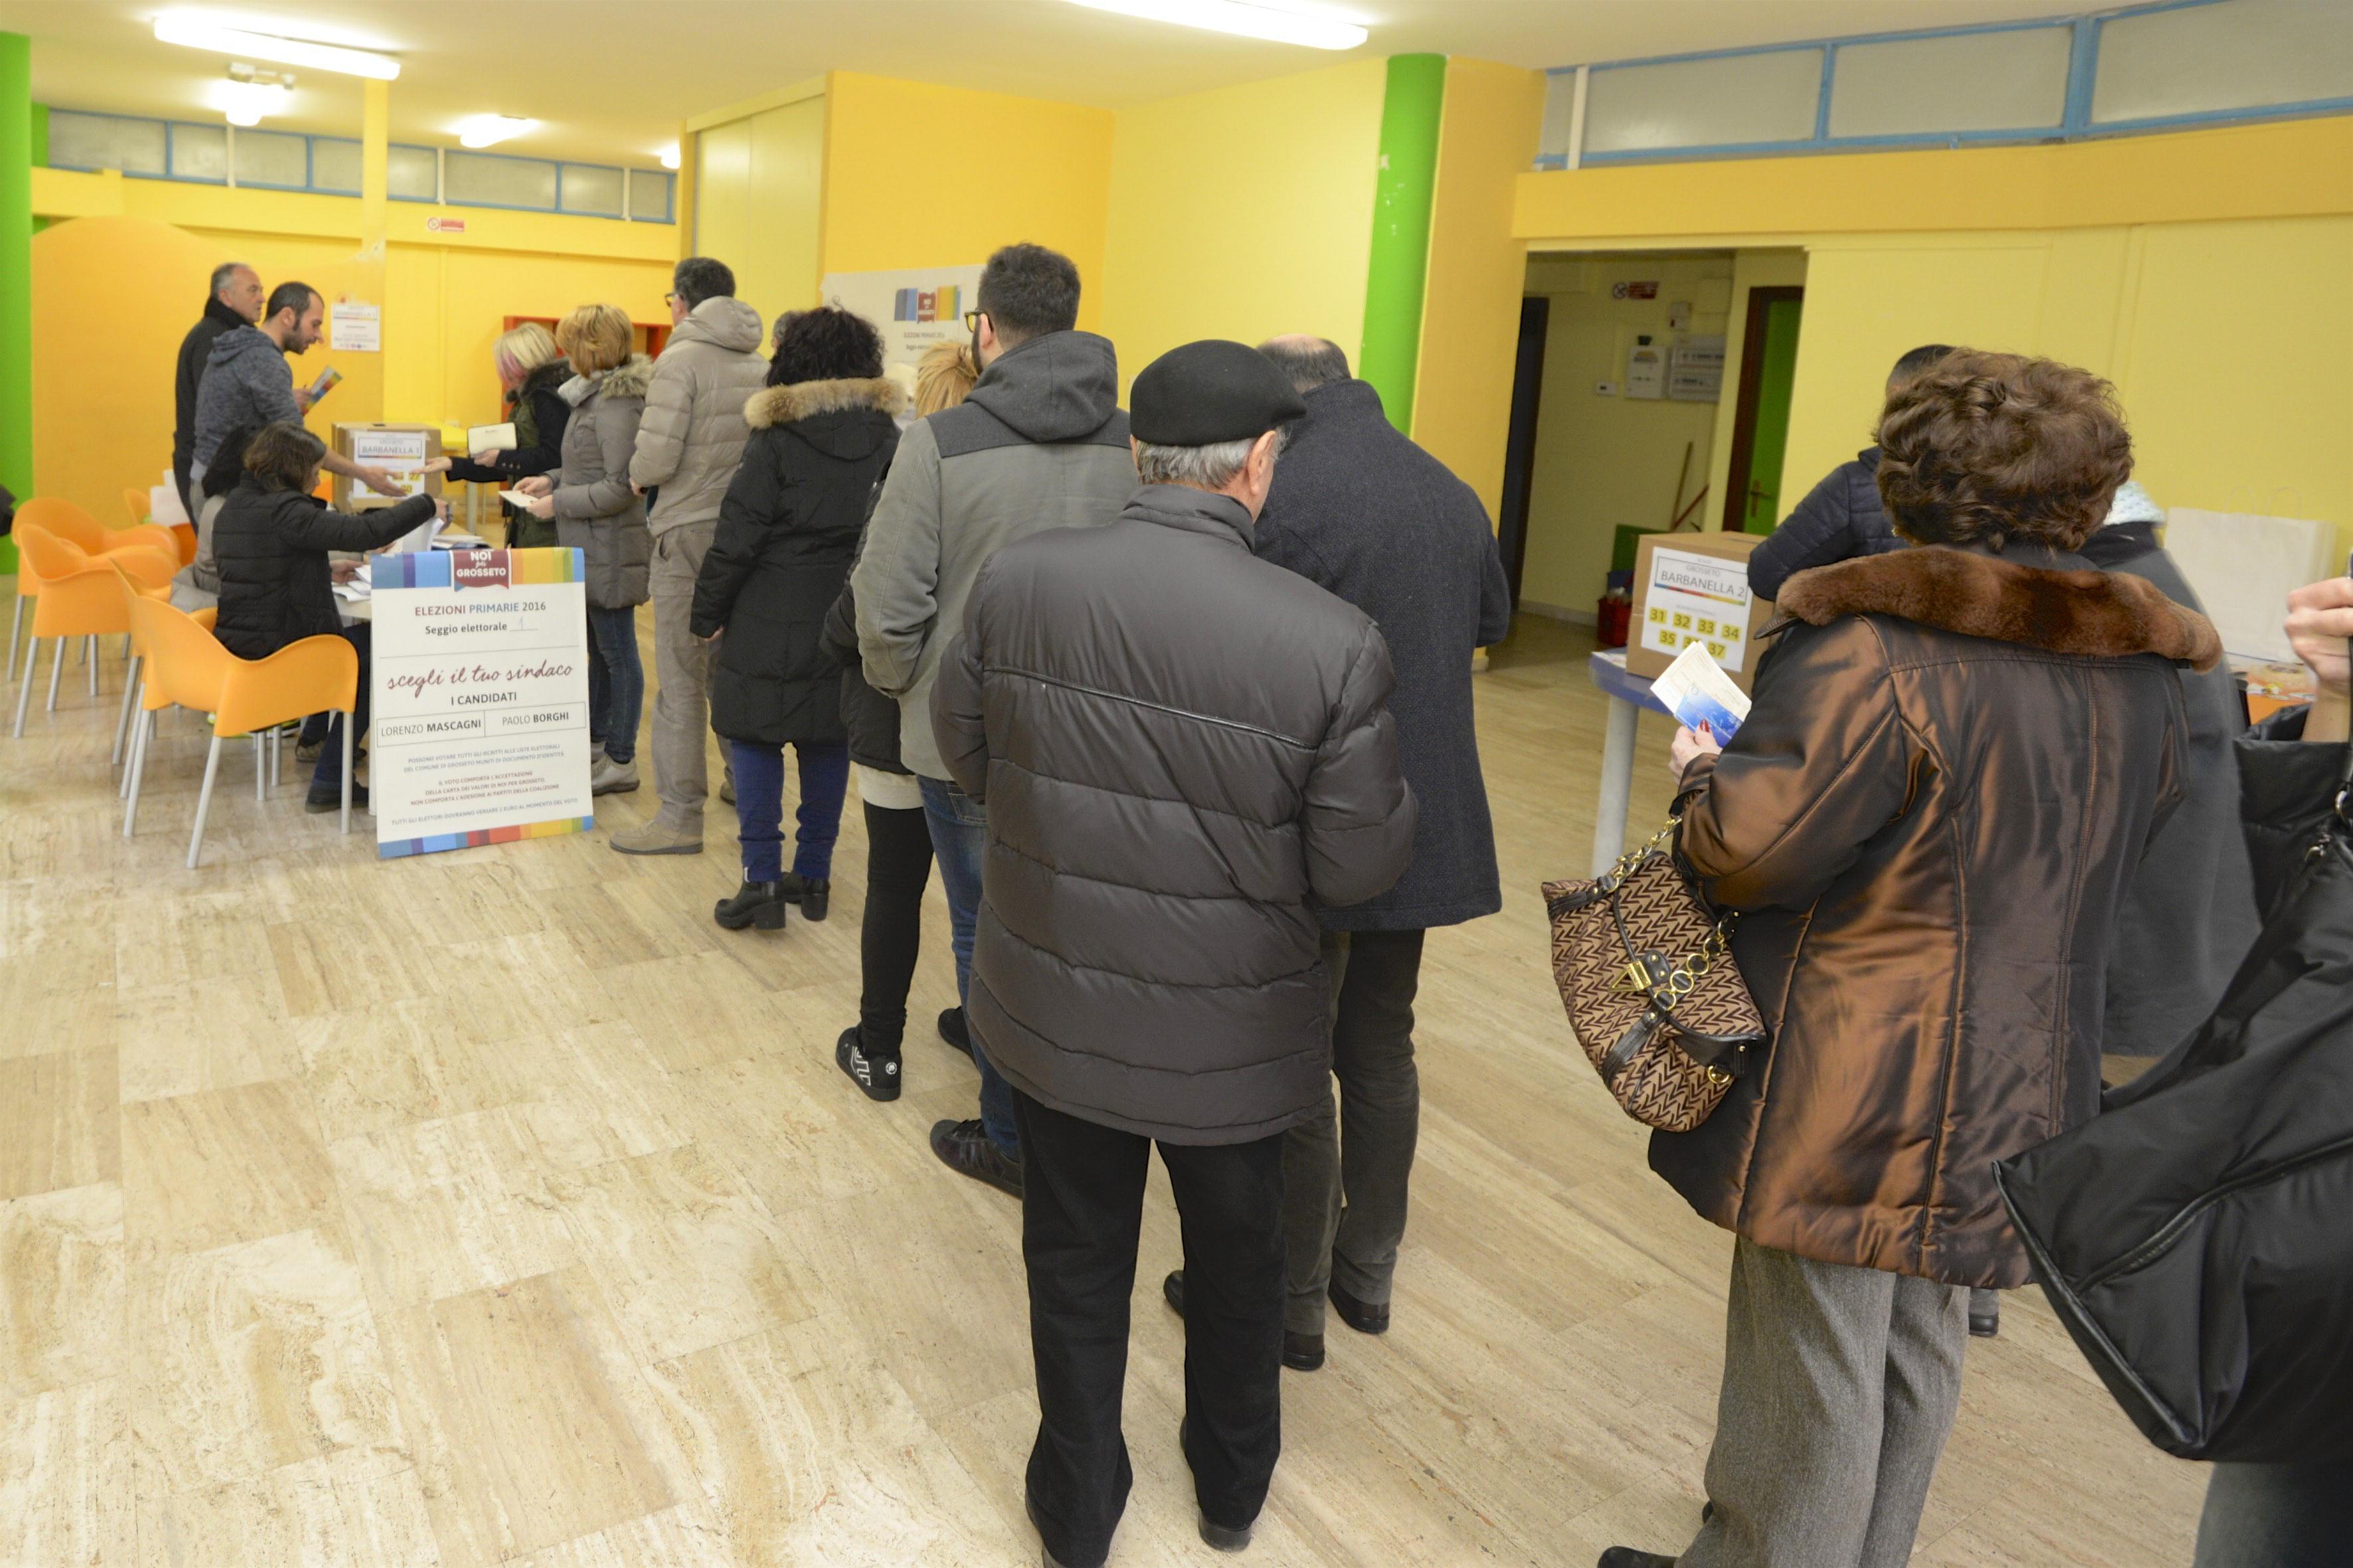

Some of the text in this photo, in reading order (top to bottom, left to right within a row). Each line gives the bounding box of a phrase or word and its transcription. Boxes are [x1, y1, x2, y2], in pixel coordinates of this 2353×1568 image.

[470, 551, 491, 561] NOI
[456, 567, 507, 577] GROSSETO
[1661, 570, 1745, 597] BARBANELLA 2
[415, 602, 547, 616] ELEZIONI PRIMARIE 2016
[425, 622, 507, 636] Seggio elettorale
[1650, 608, 1664, 622] 31
[1674, 614, 1691, 628] 32
[1698, 619, 1715, 633] 33
[1723, 626, 1739, 640] 34
[1660, 631, 1676, 644] 35
[1709, 642, 1725, 656] 37
[388, 659, 573, 698] scegli il tuo sindaco
[450, 692, 517, 706] I CANDIDATI
[502, 712, 569, 726] PAOLO BORGHI
[381, 719, 481, 737] LORENZO MASCAGNI
